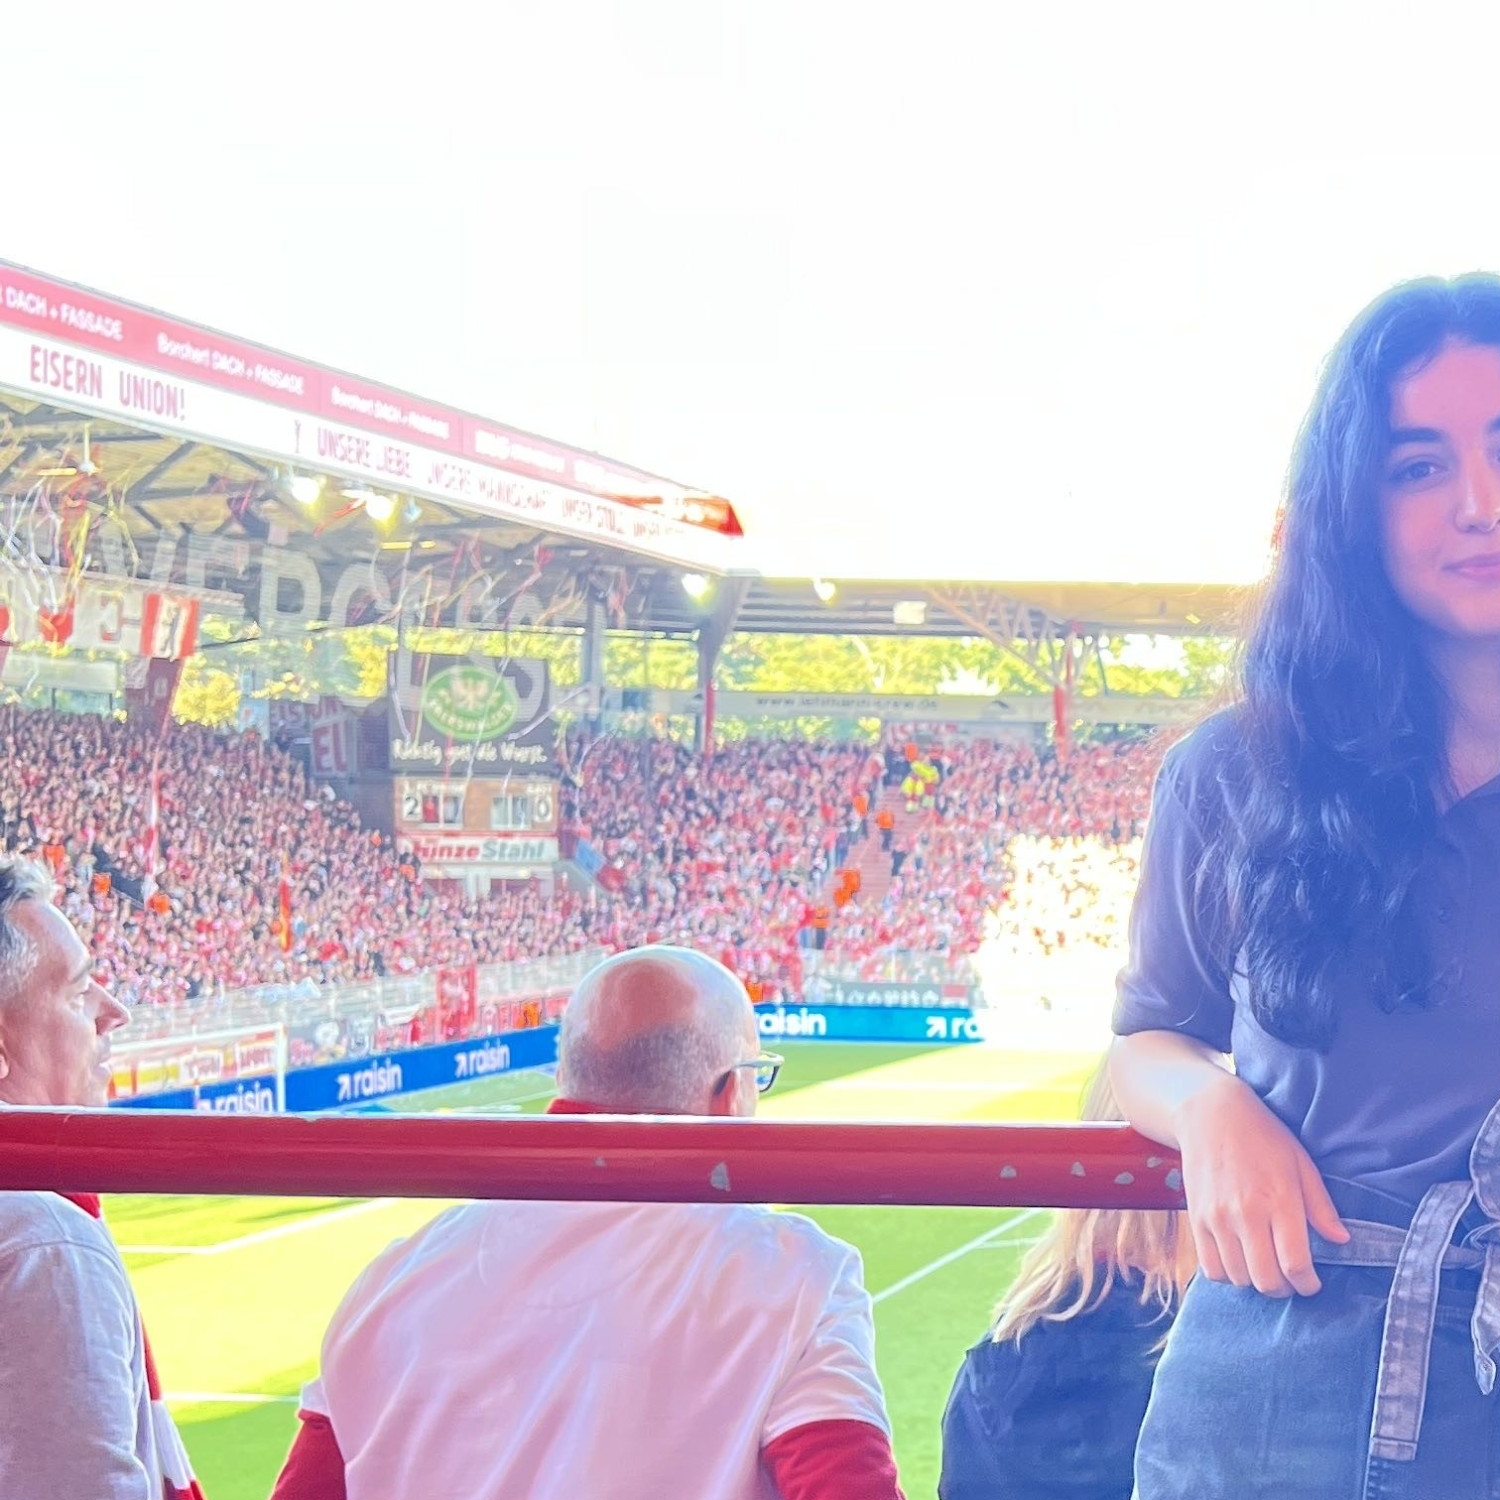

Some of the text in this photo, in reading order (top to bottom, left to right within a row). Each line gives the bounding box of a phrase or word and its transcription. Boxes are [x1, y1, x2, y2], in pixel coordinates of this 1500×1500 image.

[30, 344, 185, 421] EISERN UNION!
[318, 426, 371, 468] UNSERE
[405, 796, 550, 817] 2 0
[754, 1006, 827, 1035] aisin
[469, 1039, 511, 1074] raisin
[353, 1058, 402, 1099] raisin
[215, 1081, 273, 1112] raisin
